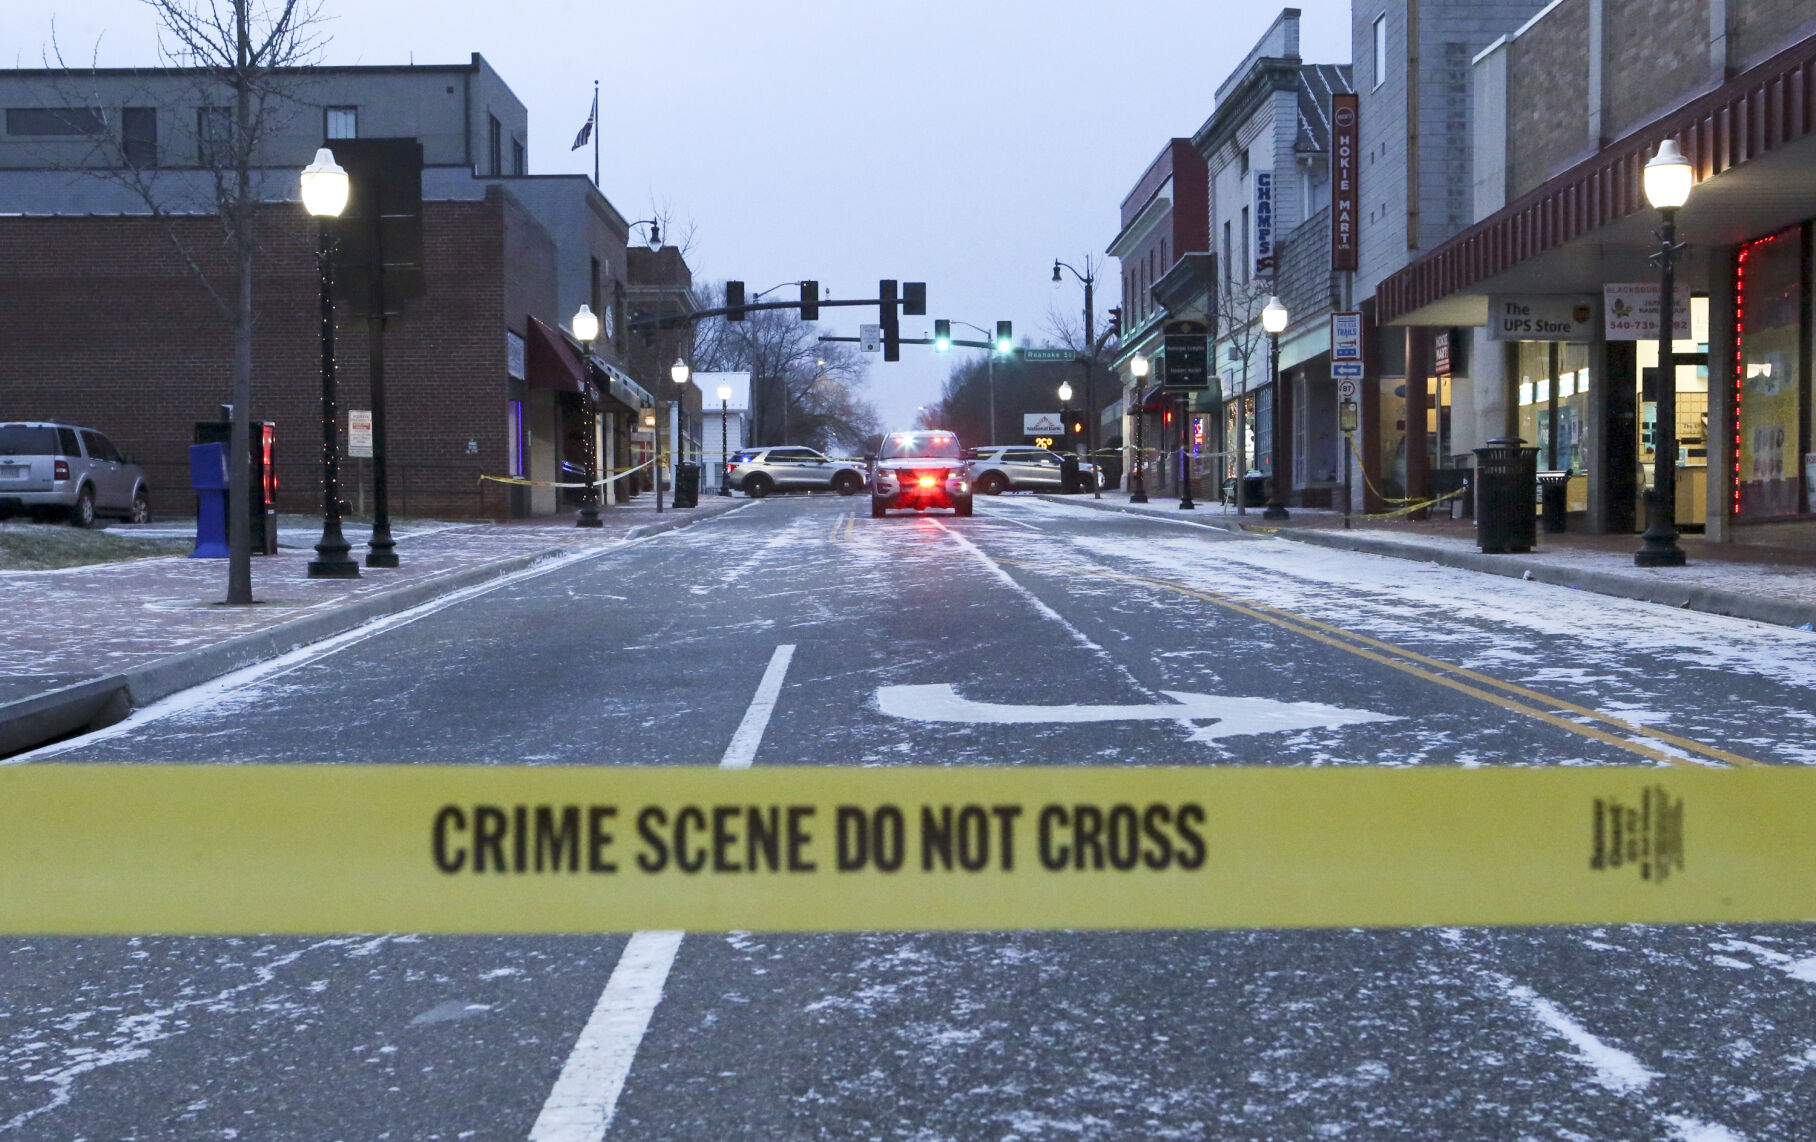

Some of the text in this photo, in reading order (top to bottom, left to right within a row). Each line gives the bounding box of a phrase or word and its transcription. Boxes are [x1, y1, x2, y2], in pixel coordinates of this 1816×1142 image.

[1339, 135, 1350, 190] HOKIE
[1257, 173, 1272, 255] CHAMPS
[1339, 200, 1350, 243] MART
[1504, 303, 1530, 316] The
[1336, 328, 1357, 336] TRAILS
[1504, 318, 1571, 333] UPS Store
[1610, 320, 1688, 330] 540-739-92
[431, 802, 1208, 875] CRIME SCENE DO NOT CROSS
